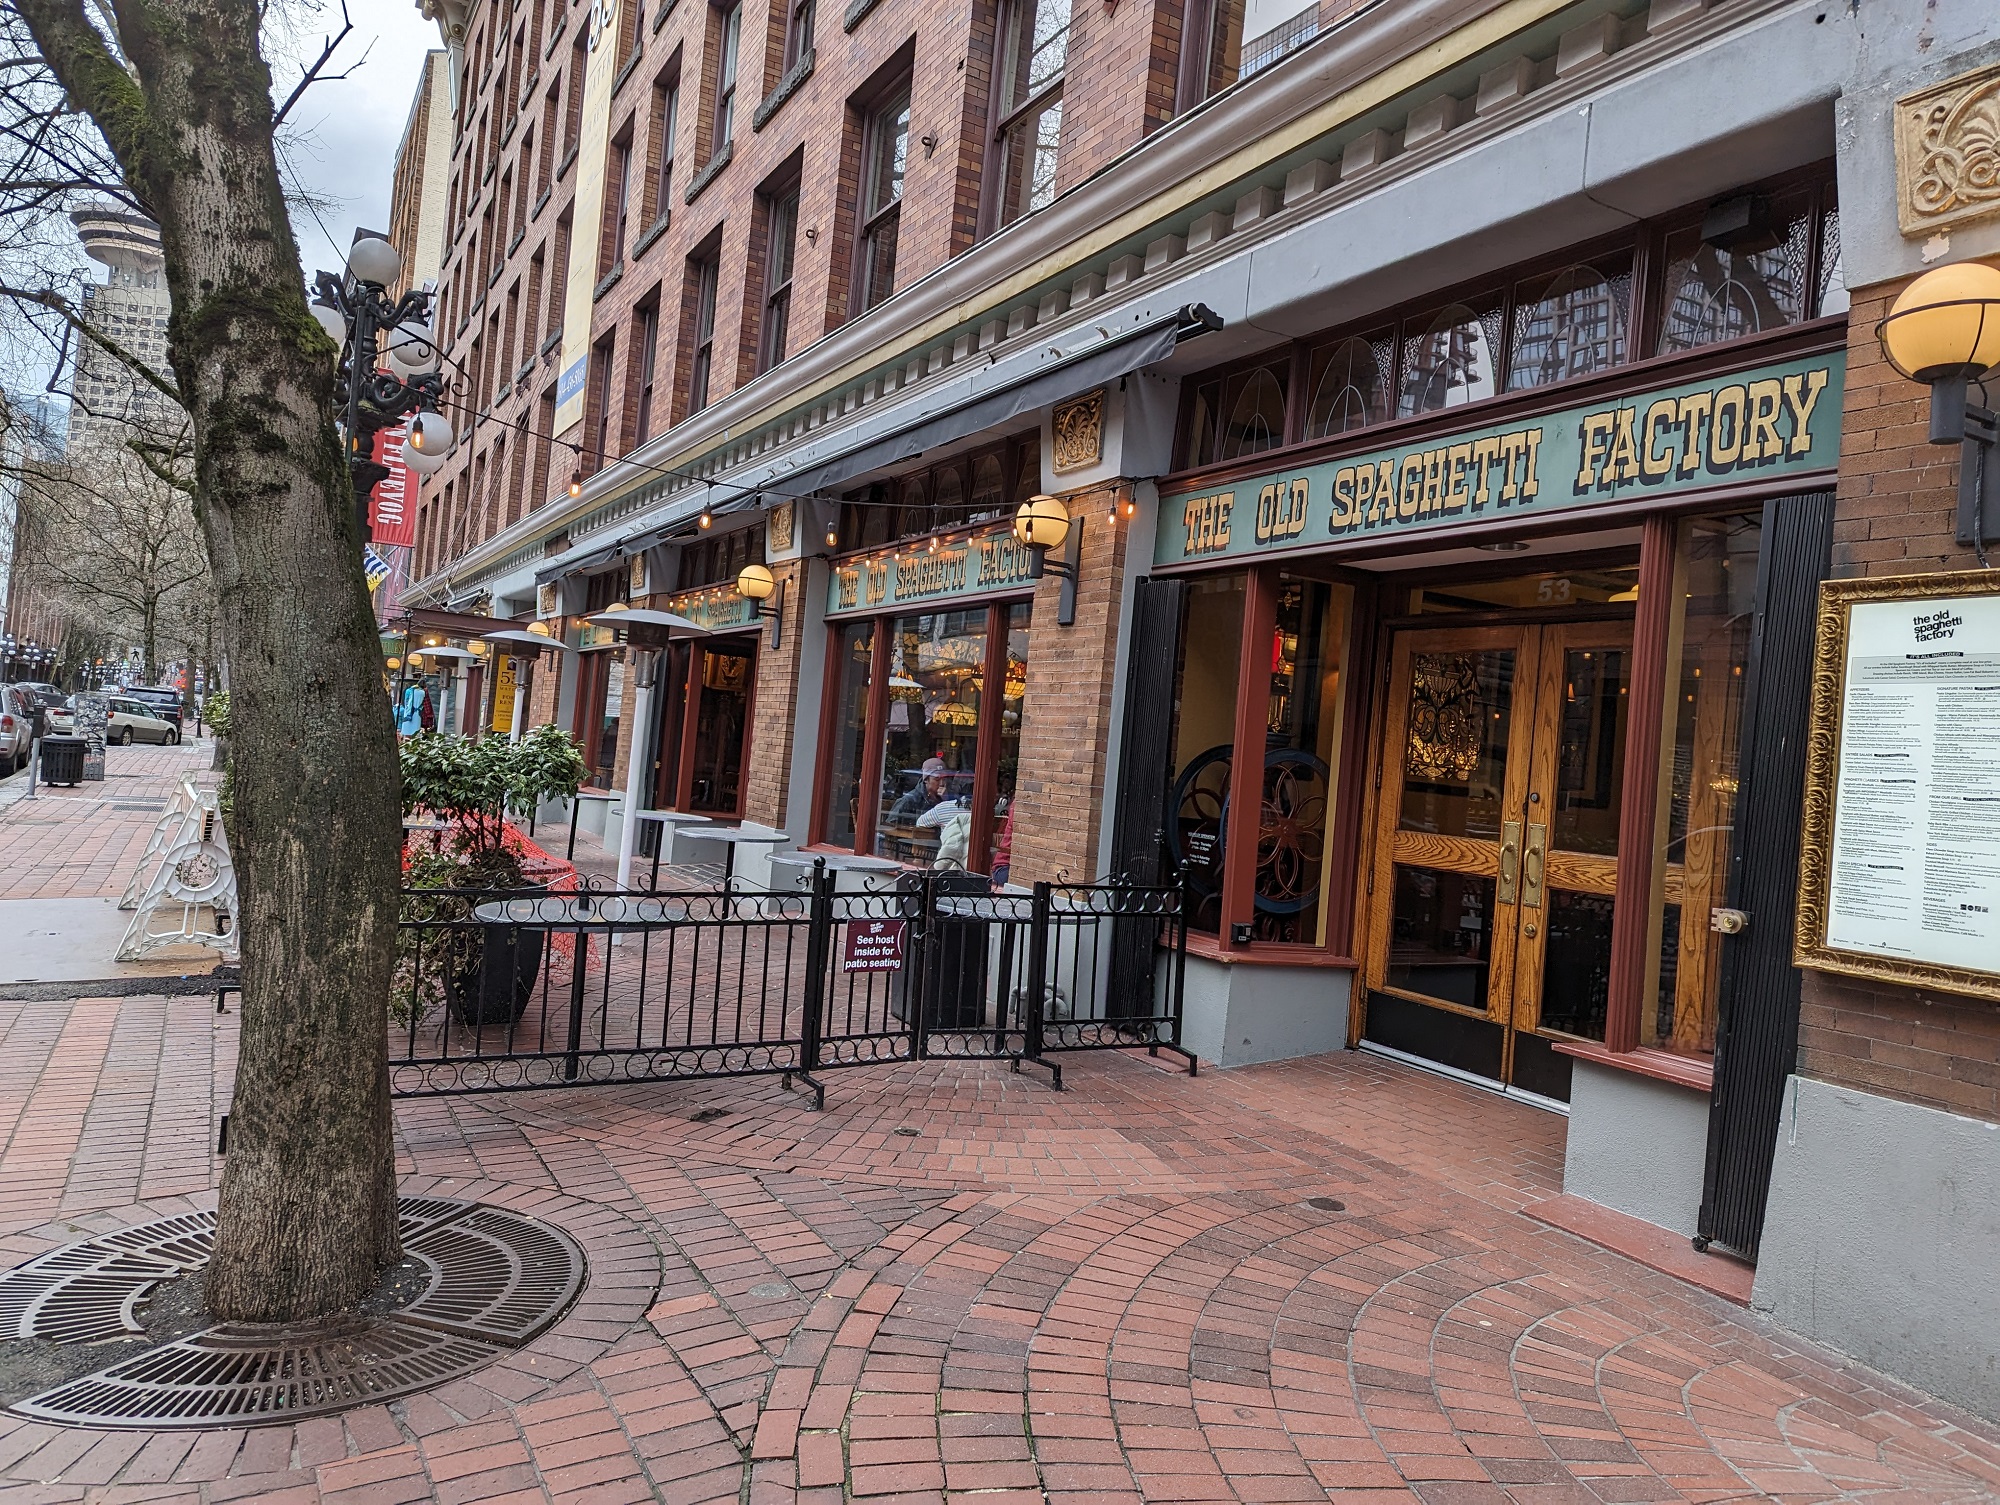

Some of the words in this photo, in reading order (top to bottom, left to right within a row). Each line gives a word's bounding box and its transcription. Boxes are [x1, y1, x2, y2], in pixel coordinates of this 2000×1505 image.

[1185, 490, 1235, 553] THE
[1256, 478, 1309, 543] OLD
[1330, 430, 1543, 533] SPAGHETTI
[1575, 367, 1830, 493] FACTORY
[838, 569, 860, 608] THE
[865, 560, 888, 606] OLD
[894, 549, 969, 600] SPAGHETTI
[977, 538, 1032, 587] FACTO
[1537, 579, 1571, 602] 53
[1913, 616, 1930, 625] the
[1932, 609, 1950, 621] old
[1914, 616, 1963, 634] spaghetti
[1915, 629, 1954, 643] factory
[857, 935, 874, 944] See
[875, 935, 895, 944] host
[854, 947, 880, 956] inside
[882, 947, 895, 956] for
[845, 959, 868, 970] patio
[869, 958, 901, 969] seating
